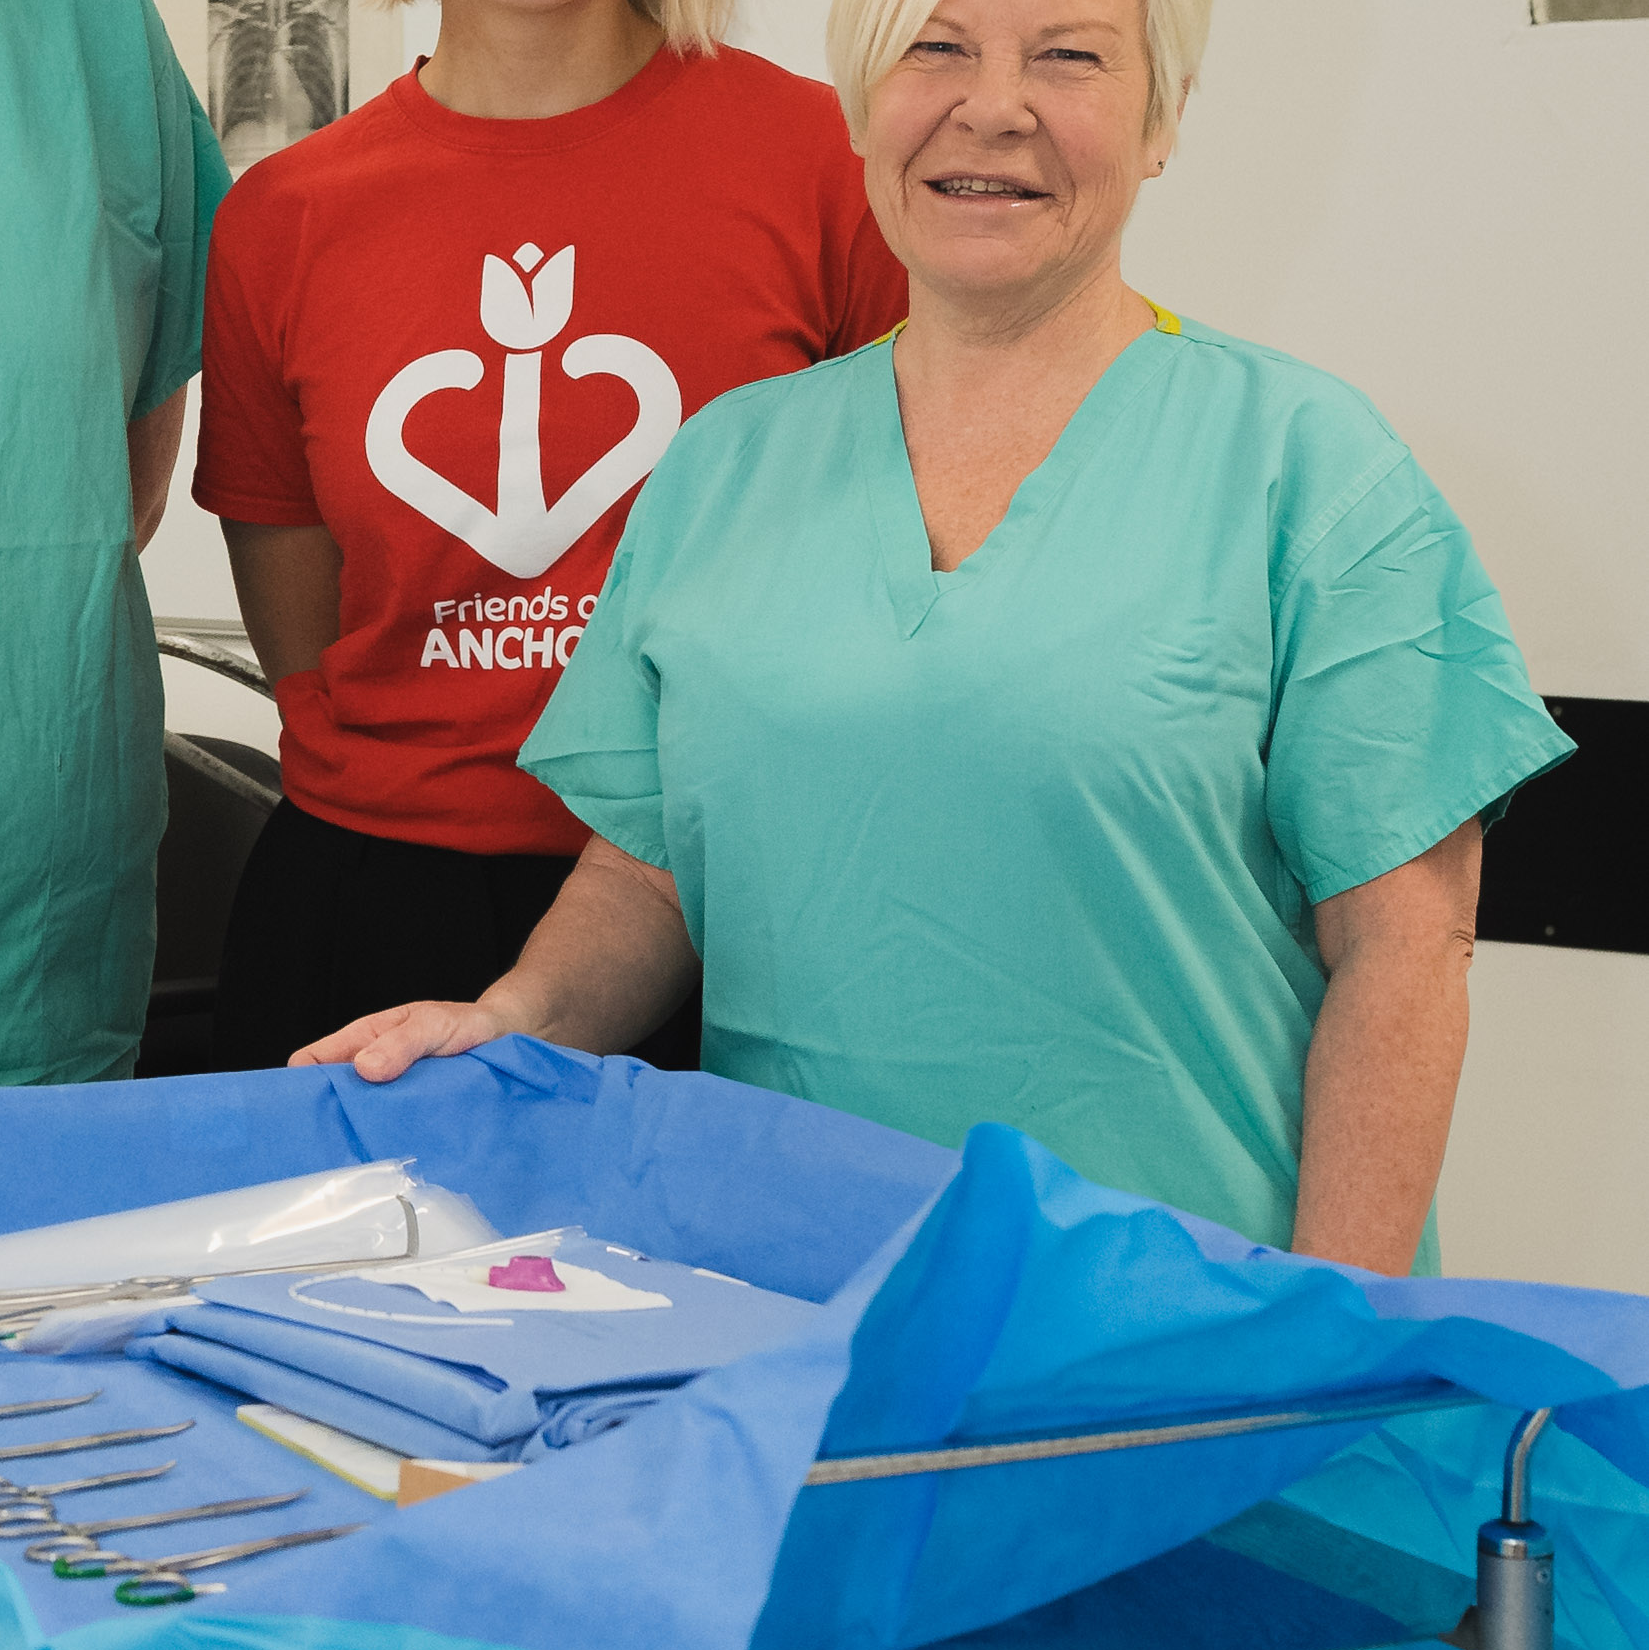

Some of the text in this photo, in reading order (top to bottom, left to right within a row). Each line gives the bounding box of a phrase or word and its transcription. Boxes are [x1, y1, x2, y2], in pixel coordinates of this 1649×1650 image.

[433, 584, 599, 625] Friends o
[419, 624, 586, 671] ANCHO
